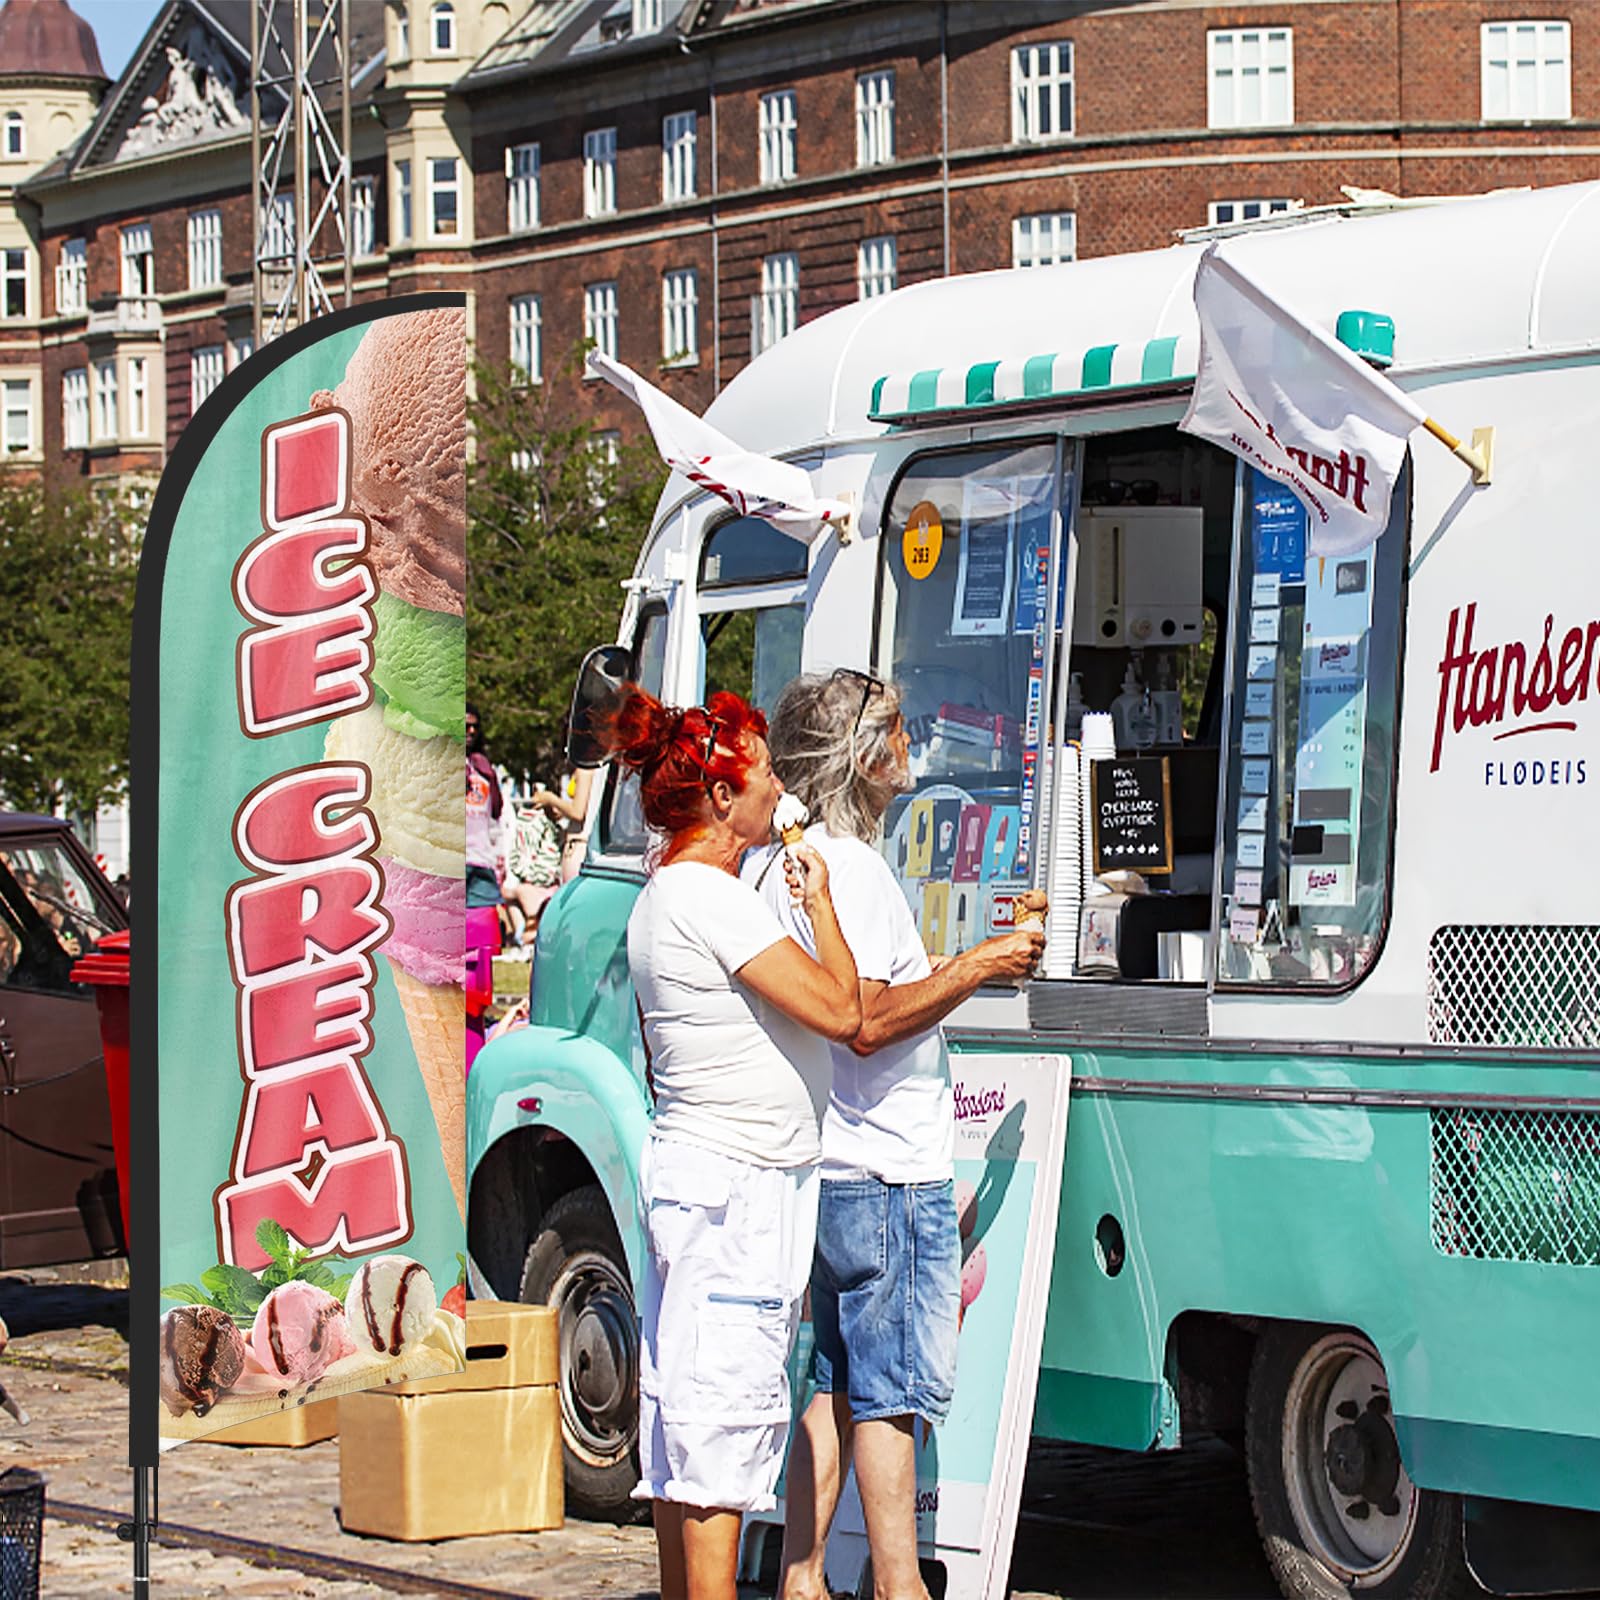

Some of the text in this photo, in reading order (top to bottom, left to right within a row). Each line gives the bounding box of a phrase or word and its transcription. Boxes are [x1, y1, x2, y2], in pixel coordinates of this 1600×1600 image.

[233, 408, 379, 738] ICE
[1485, 760, 1586, 786] FLØDEIS
[213, 761, 413, 1268] CREAM
